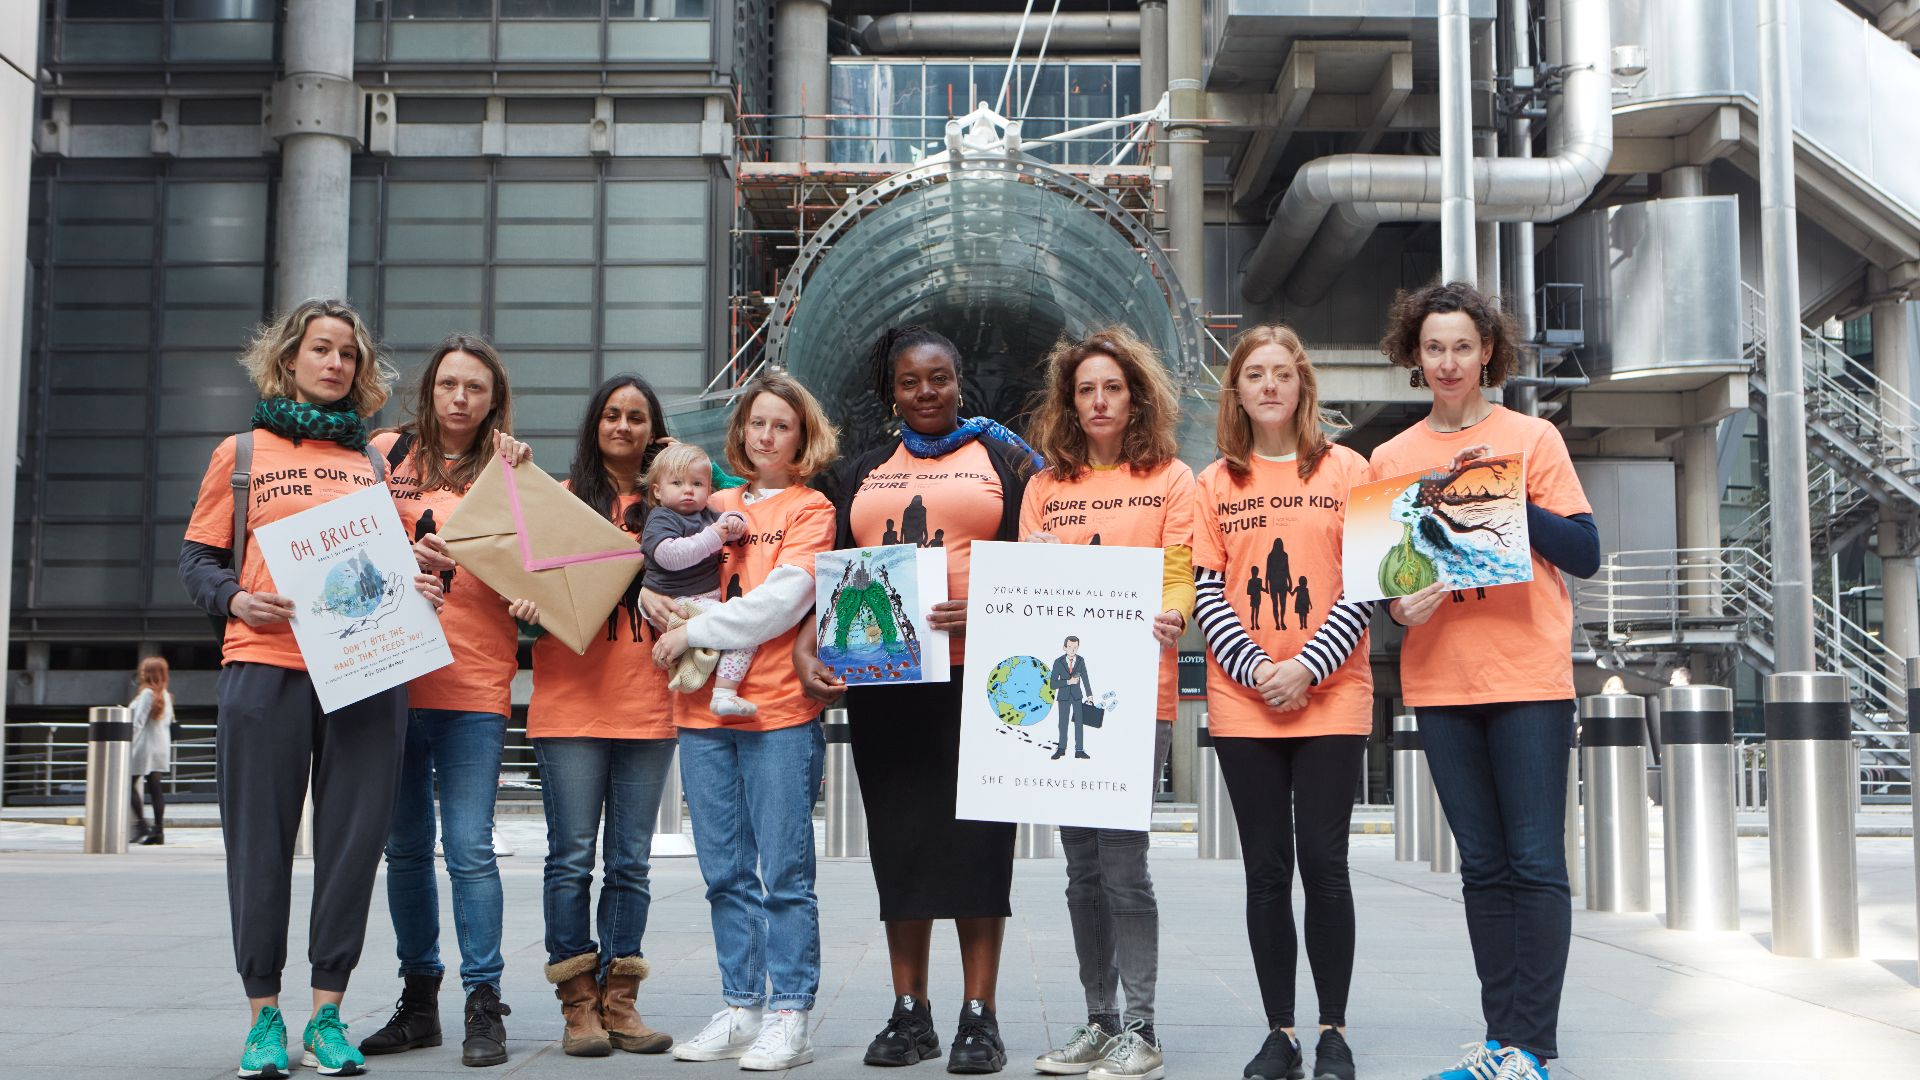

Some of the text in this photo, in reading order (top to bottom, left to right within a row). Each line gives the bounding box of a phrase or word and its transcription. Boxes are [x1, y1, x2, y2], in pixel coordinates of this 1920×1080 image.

[253, 468, 308, 491] INSURE
[314, 467, 348, 483] OUR
[916, 472, 949, 480] OUR
[256, 484, 313, 508] FUTURE
[391, 489, 423, 501] TURE
[1091, 498, 1123, 510] OUR
[1218, 496, 1265, 516] INSURE
[1270, 496, 1304, 509] OUR
[1043, 515, 1087, 532] FUTURE
[1219, 515, 1267, 535] FUTURE
[291, 515, 382, 561] OH BRUCE!
[1034, 587, 1081, 597] WALKING
[1086, 588, 1104, 598] ALL
[1110, 590, 1139, 599] OVER
[985, 602, 1145, 622] OUR OTHER MOTHER
[343, 626, 406, 655] DON'T BITE THE
[334, 658, 355, 672] HAND
[358, 649, 378, 662] THAT
[381, 639, 406, 652] FEEDS
[981, 774, 1129, 792] SHE DESERVES BETTER
